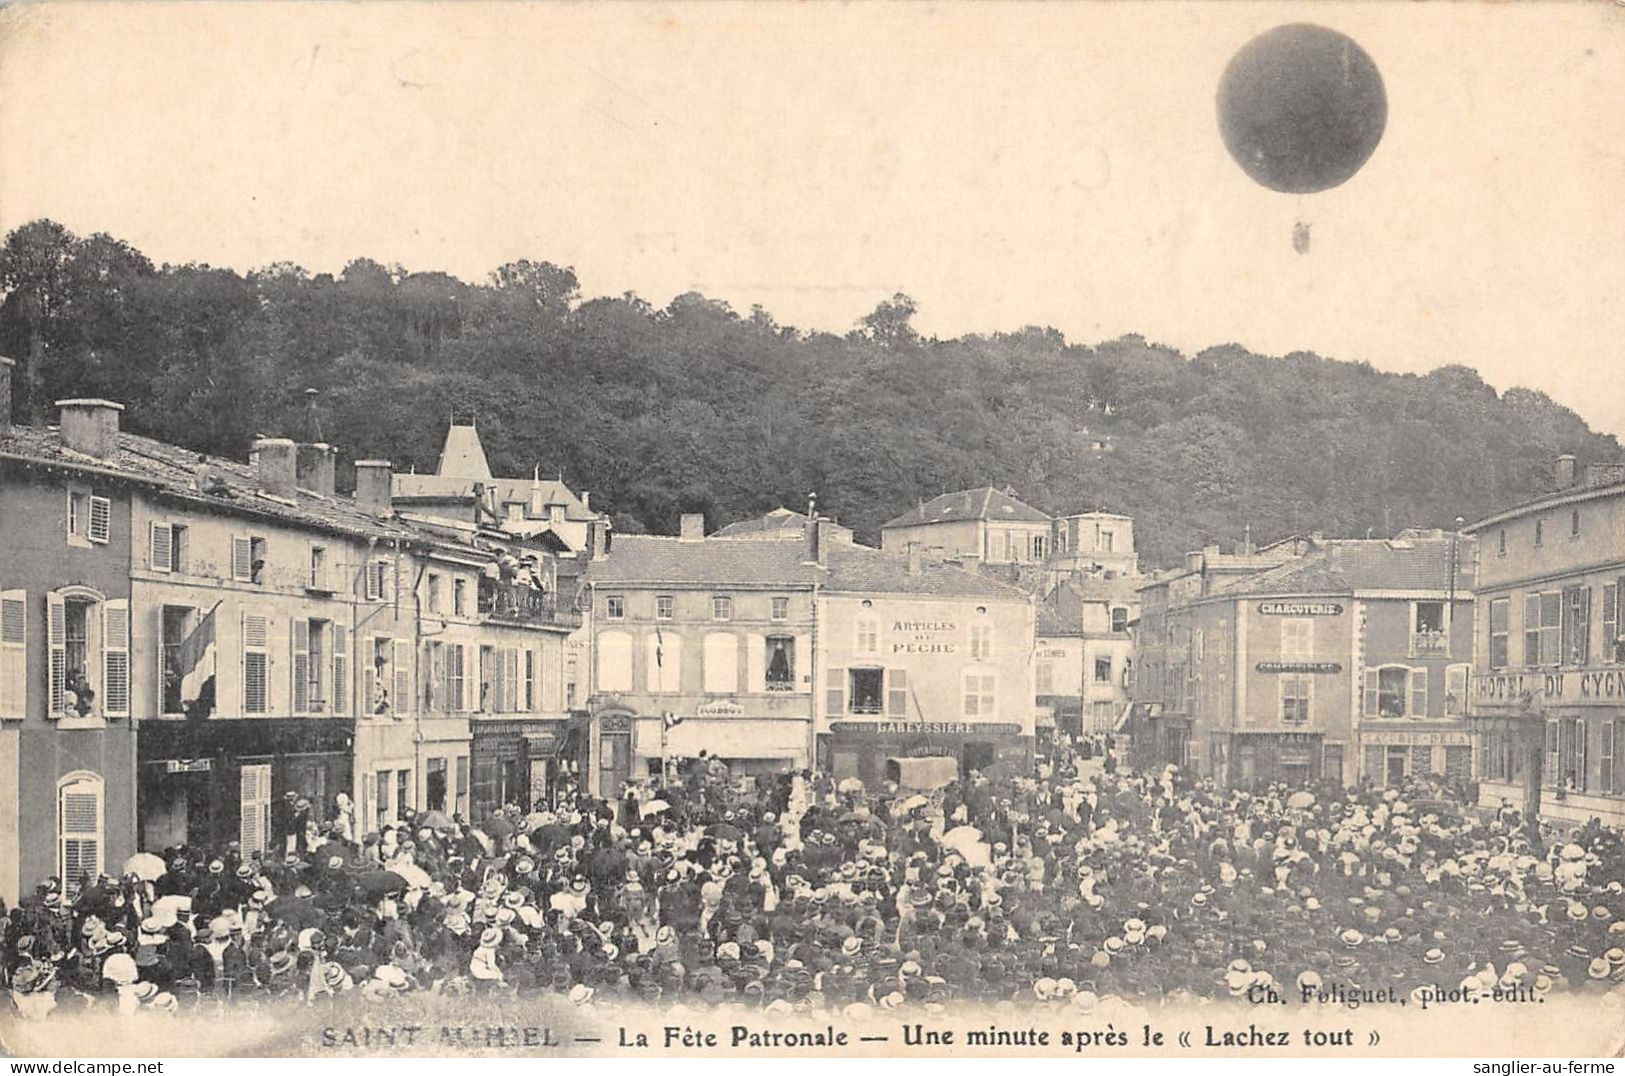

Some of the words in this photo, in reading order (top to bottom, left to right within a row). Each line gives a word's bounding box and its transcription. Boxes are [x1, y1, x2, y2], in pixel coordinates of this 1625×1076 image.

[1261, 604, 1336, 614] CHARCUTERIE
[893, 621, 957, 631] ARTICLES
[1545, 674, 1564, 697] DU
